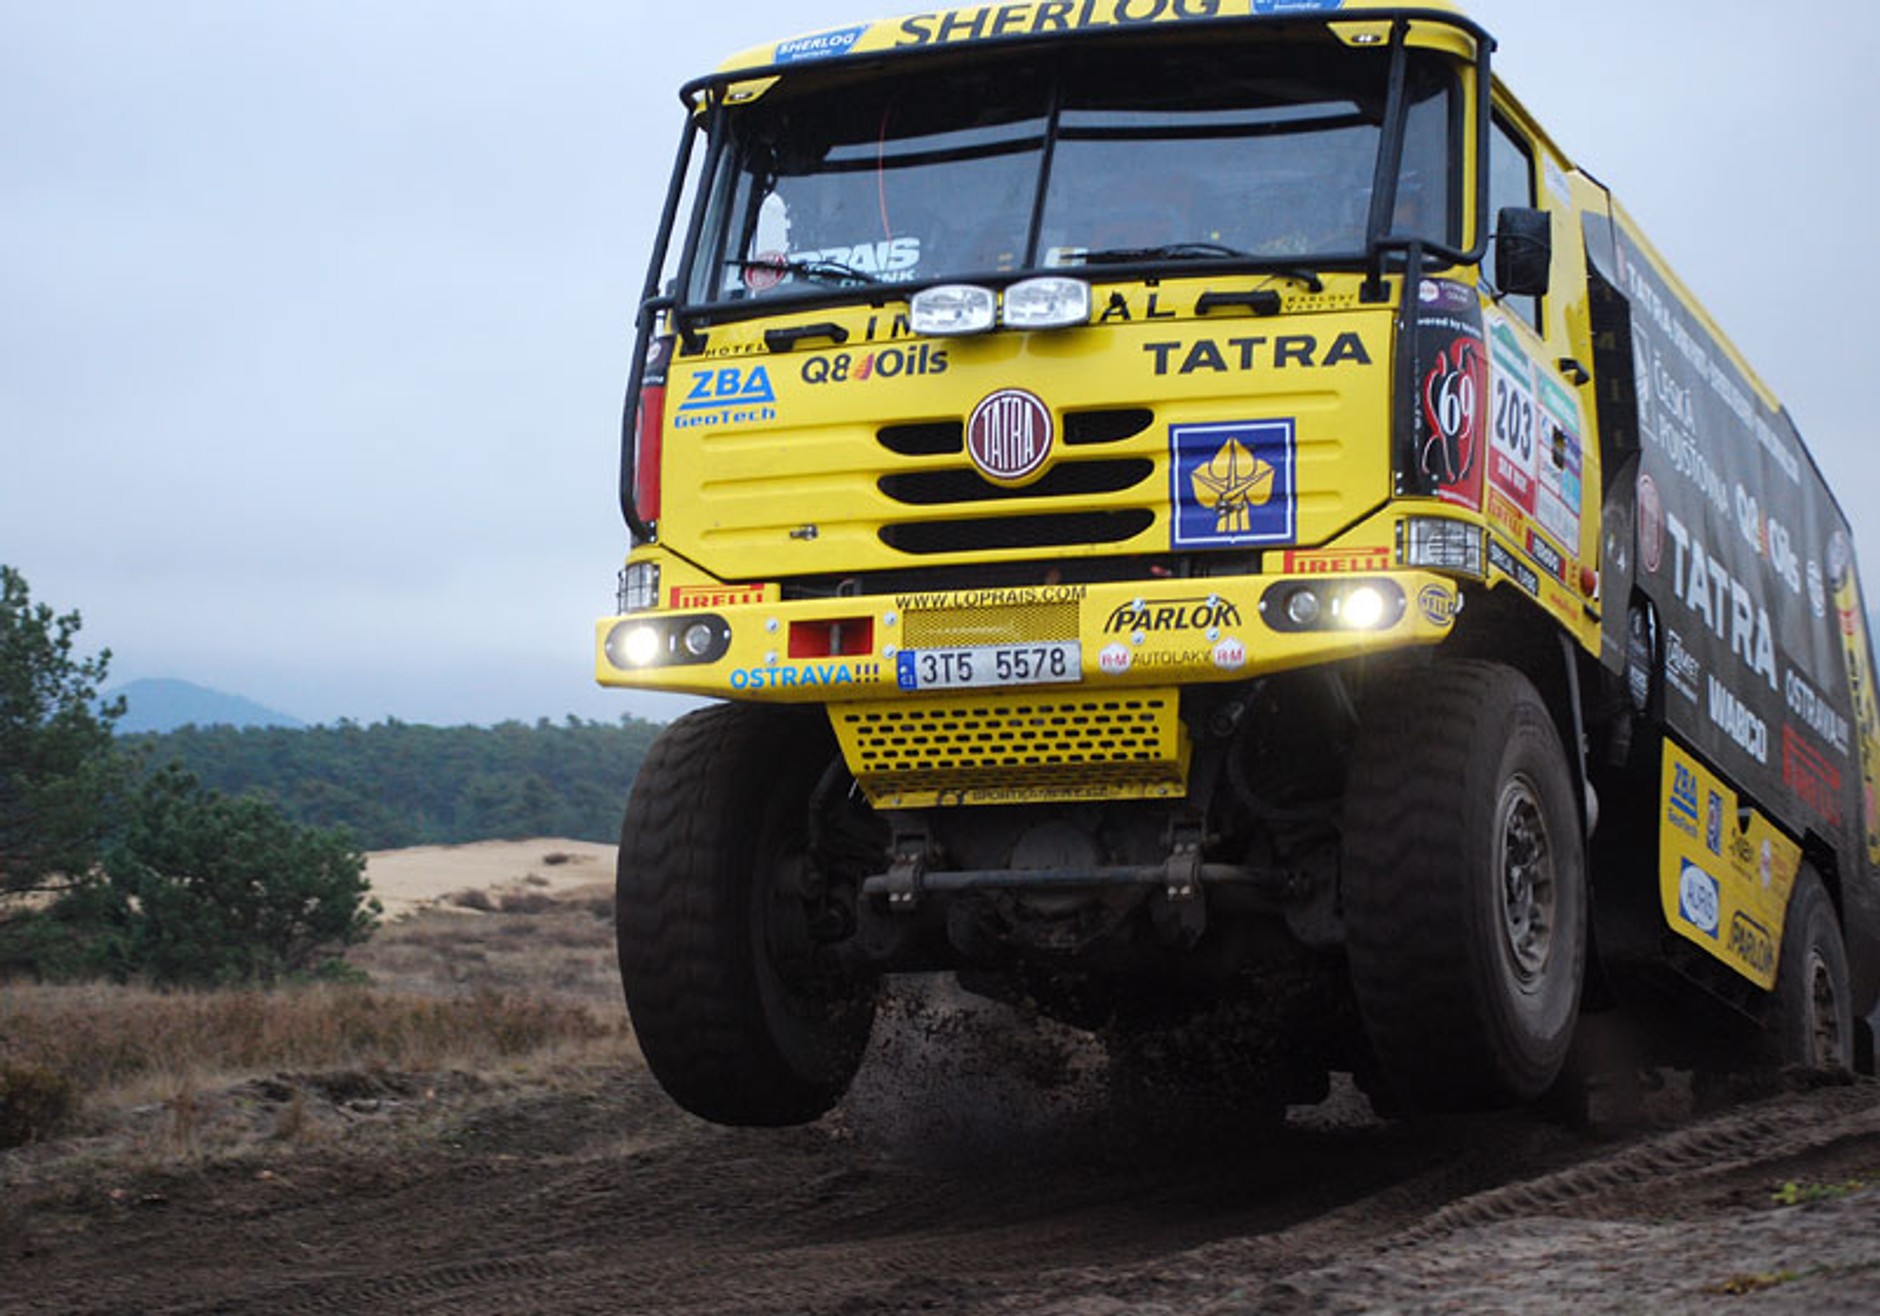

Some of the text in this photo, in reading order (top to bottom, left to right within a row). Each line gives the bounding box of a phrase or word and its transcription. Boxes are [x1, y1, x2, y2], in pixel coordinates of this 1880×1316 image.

[895, 0, 1223, 47] SHERLOG
[779, 33, 855, 56] SHERLOG
[704, 342, 768, 358] HOTEL
[801, 344, 949, 385] Q8 Oils
[1143, 331, 1372, 376] TATRA
[686, 366, 776, 401] ZBA
[673, 407, 776, 429] GeoTech
[1438, 371, 1475, 438] 69
[1496, 378, 1532, 462] 203
[981, 396, 1035, 472] TATRA
[1282, 545, 1391, 574] PIRELLI
[669, 582, 765, 610] PIRELLI
[896, 584, 1087, 610] WWW.LOPRAIS.COM
[1667, 512, 1778, 692] TATRA
[1114, 603, 1233, 633] PARLOK
[921, 647, 1067, 685] 3T5 5578
[1132, 649, 1212, 665] AUTOLAKY
[730, 663, 881, 690] OSTRAVA!!!
[1708, 673, 1767, 765] WABCO
[1672, 761, 1698, 808] ZBA
